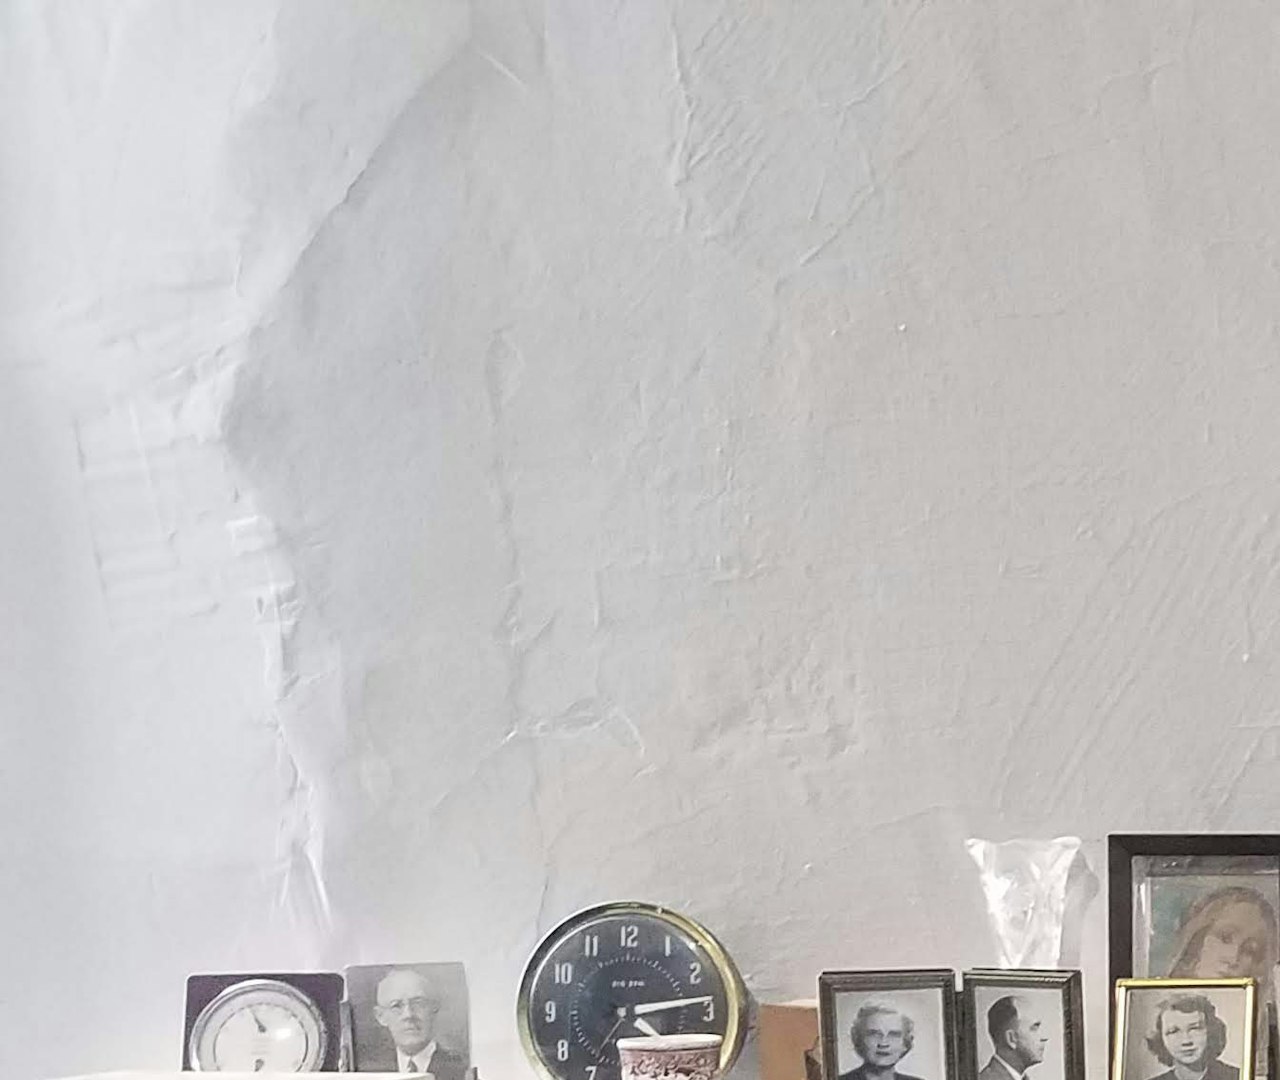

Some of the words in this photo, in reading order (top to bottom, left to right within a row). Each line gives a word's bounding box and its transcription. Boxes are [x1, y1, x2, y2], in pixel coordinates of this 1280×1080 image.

[584, 935, 599, 957] 11
[620, 925, 639, 948] 12
[664, 935, 672, 957] 1
[554, 962, 573, 985] 10
[689, 962, 701, 985] 2
[544, 1000, 556, 1023] 9
[702, 1000, 715, 1022] 3
[556, 1039, 569, 1062] 8
